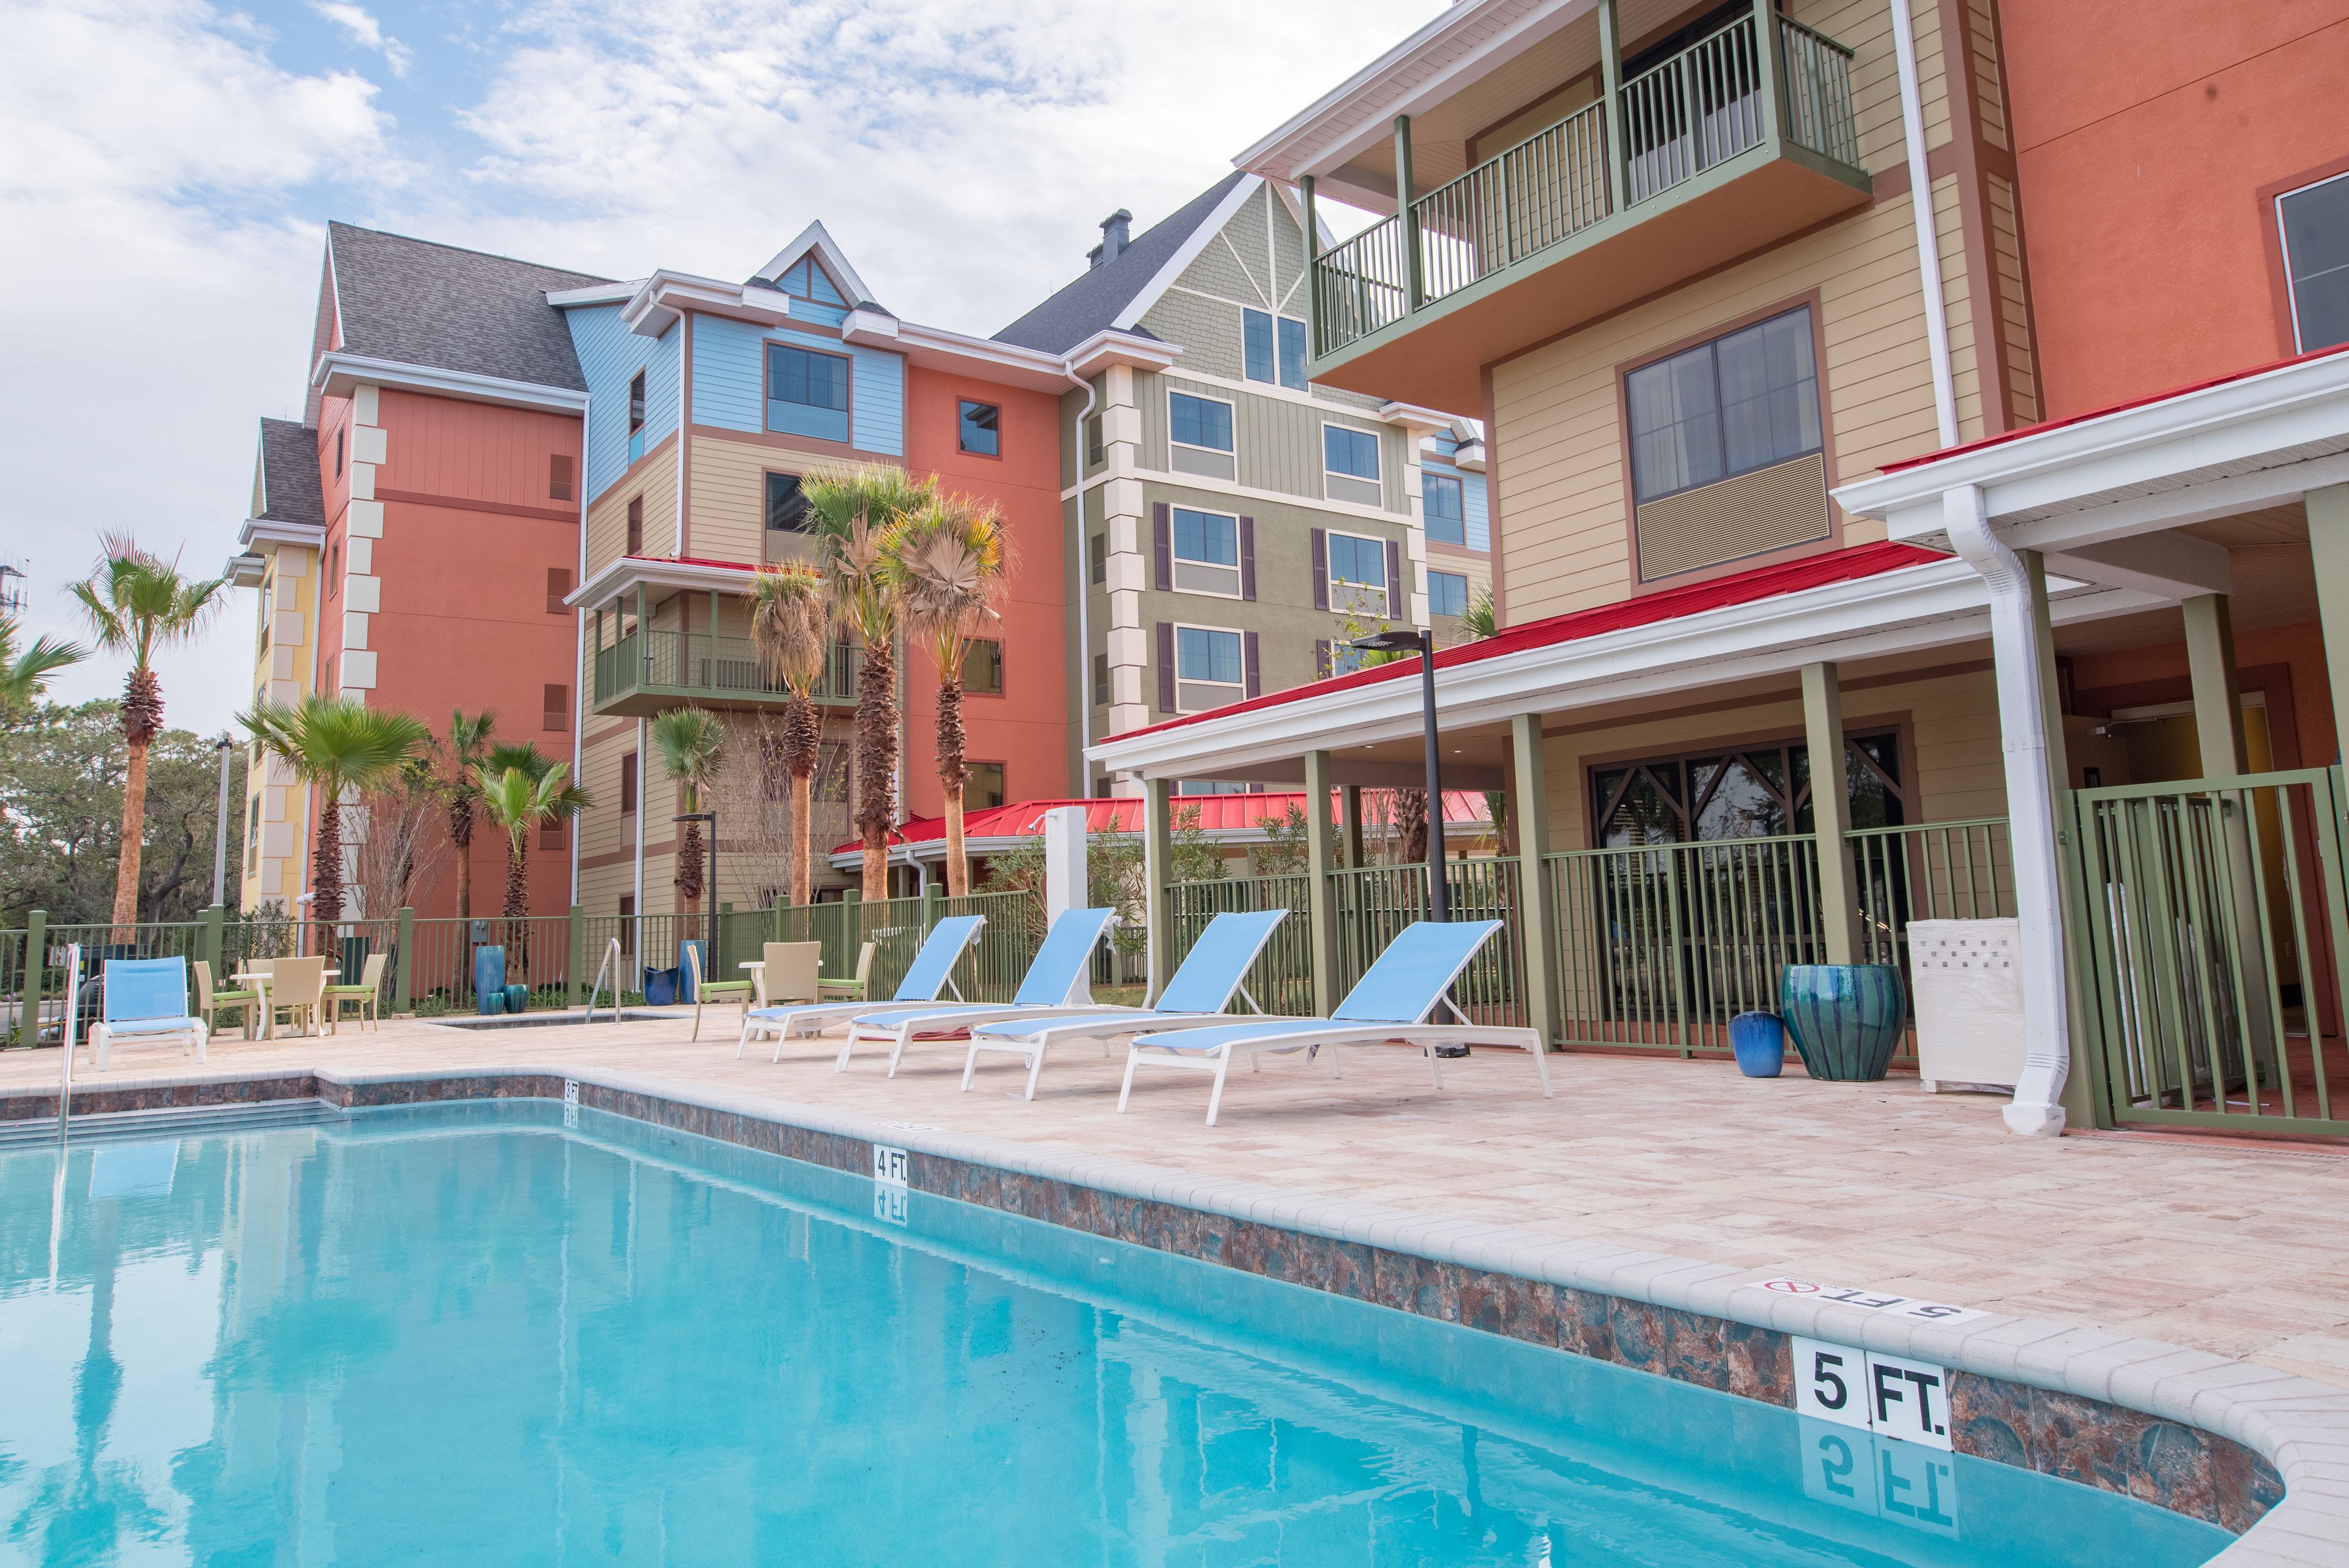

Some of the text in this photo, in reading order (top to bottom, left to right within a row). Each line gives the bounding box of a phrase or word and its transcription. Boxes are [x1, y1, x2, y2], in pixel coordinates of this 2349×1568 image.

[566, 1082, 570, 1098] 3
[878, 1150, 906, 1181] 4 FT.
[1907, 1306, 1962, 1318] 5
[1814, 1351, 1945, 1435] 5 FT.
